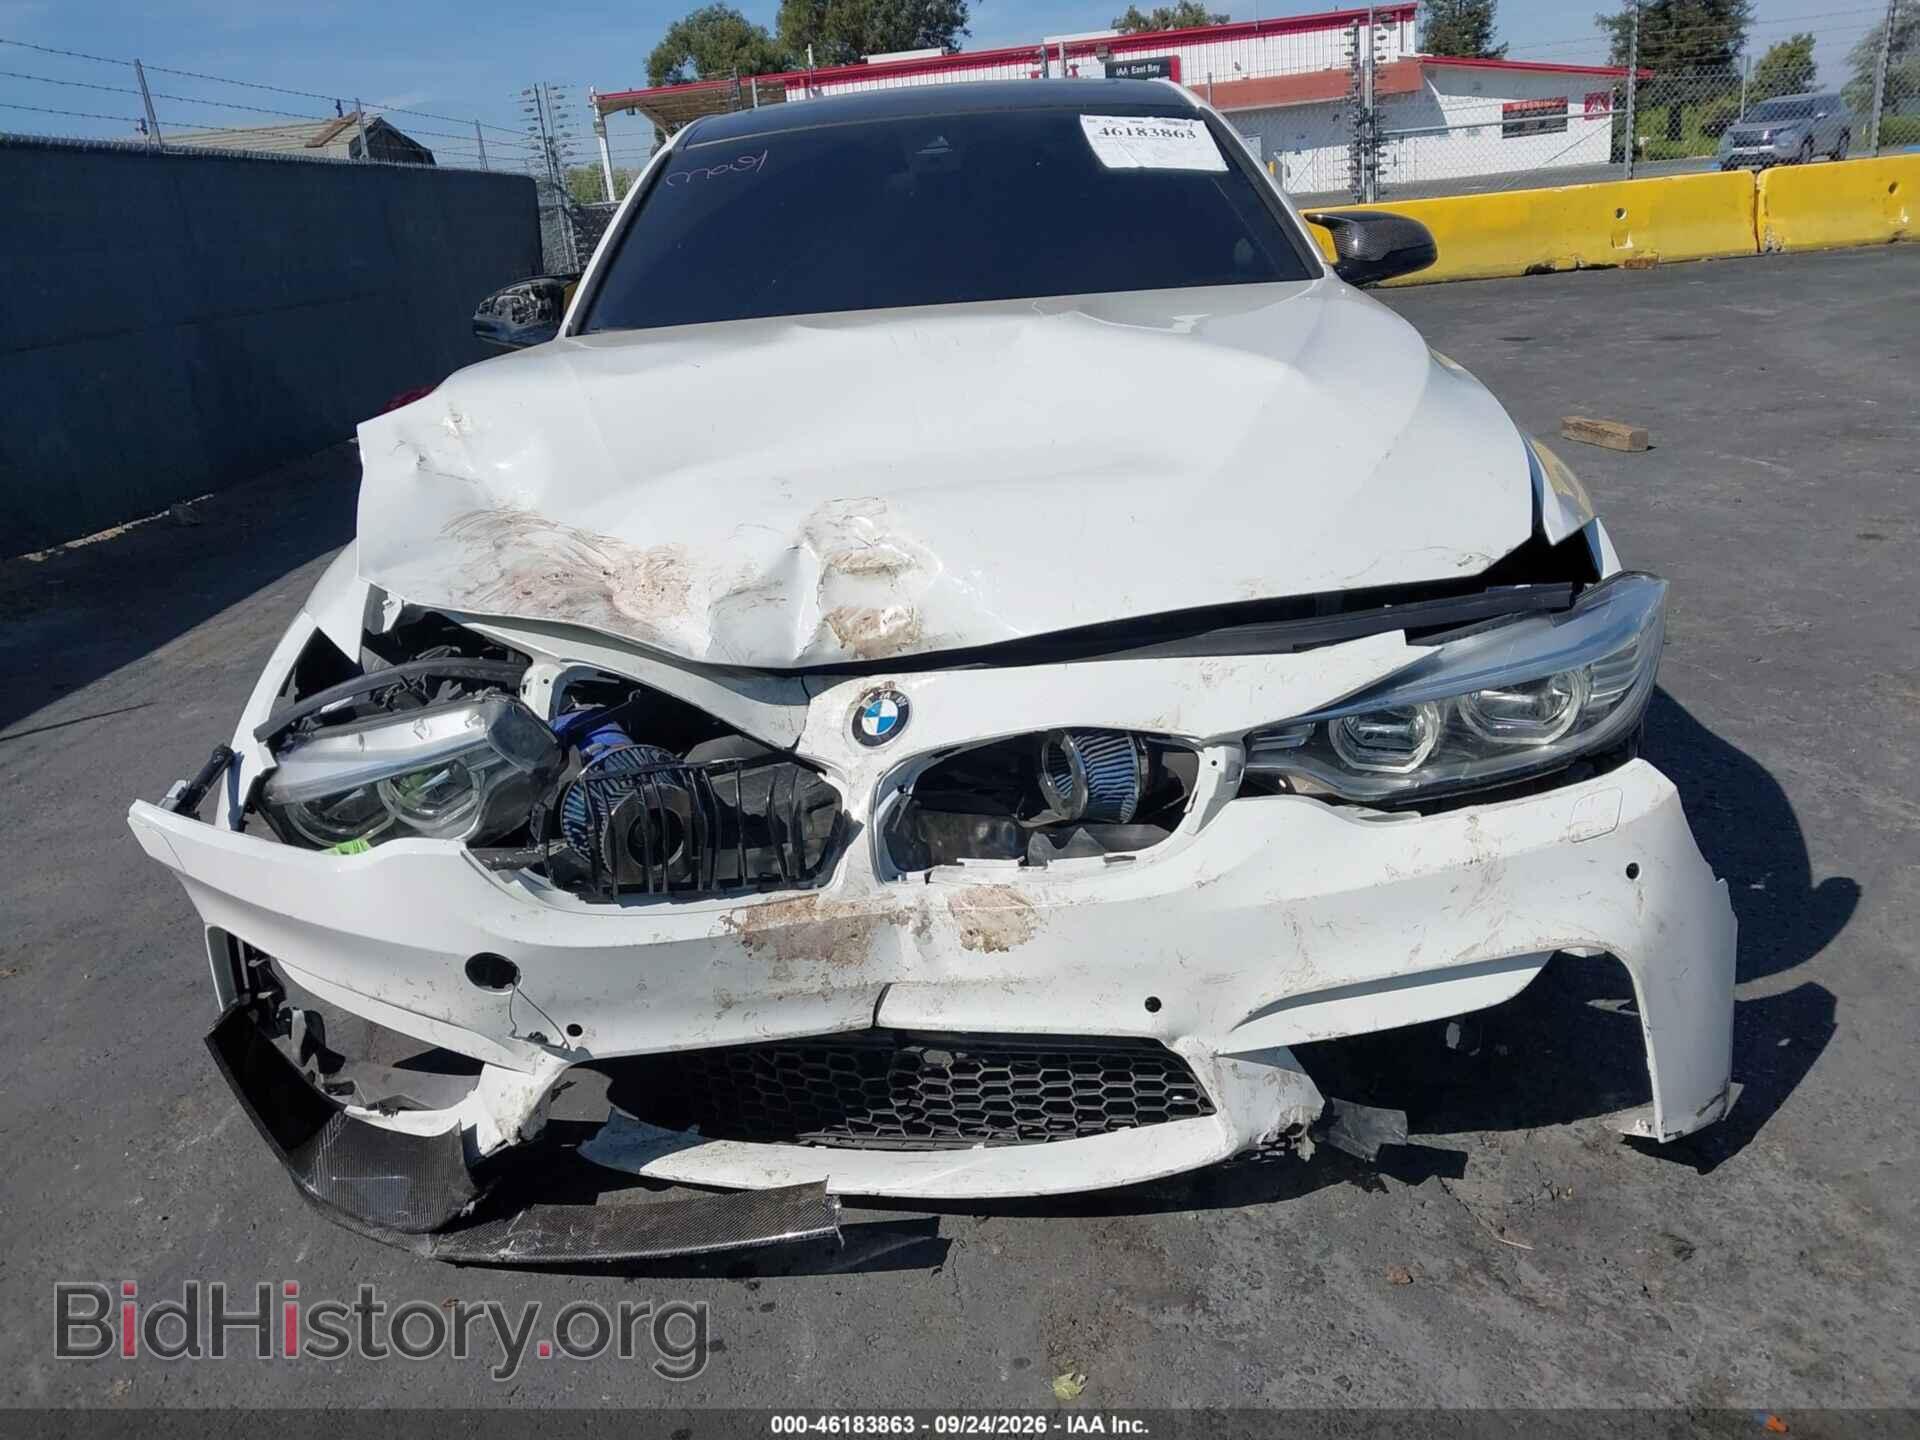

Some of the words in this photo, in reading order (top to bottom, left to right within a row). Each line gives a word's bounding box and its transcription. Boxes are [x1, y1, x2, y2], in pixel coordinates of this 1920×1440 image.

[1131, 64, 1146, 74] East
[1147, 63, 1161, 73] Bay
[1099, 126, 1197, 139] 46183863
